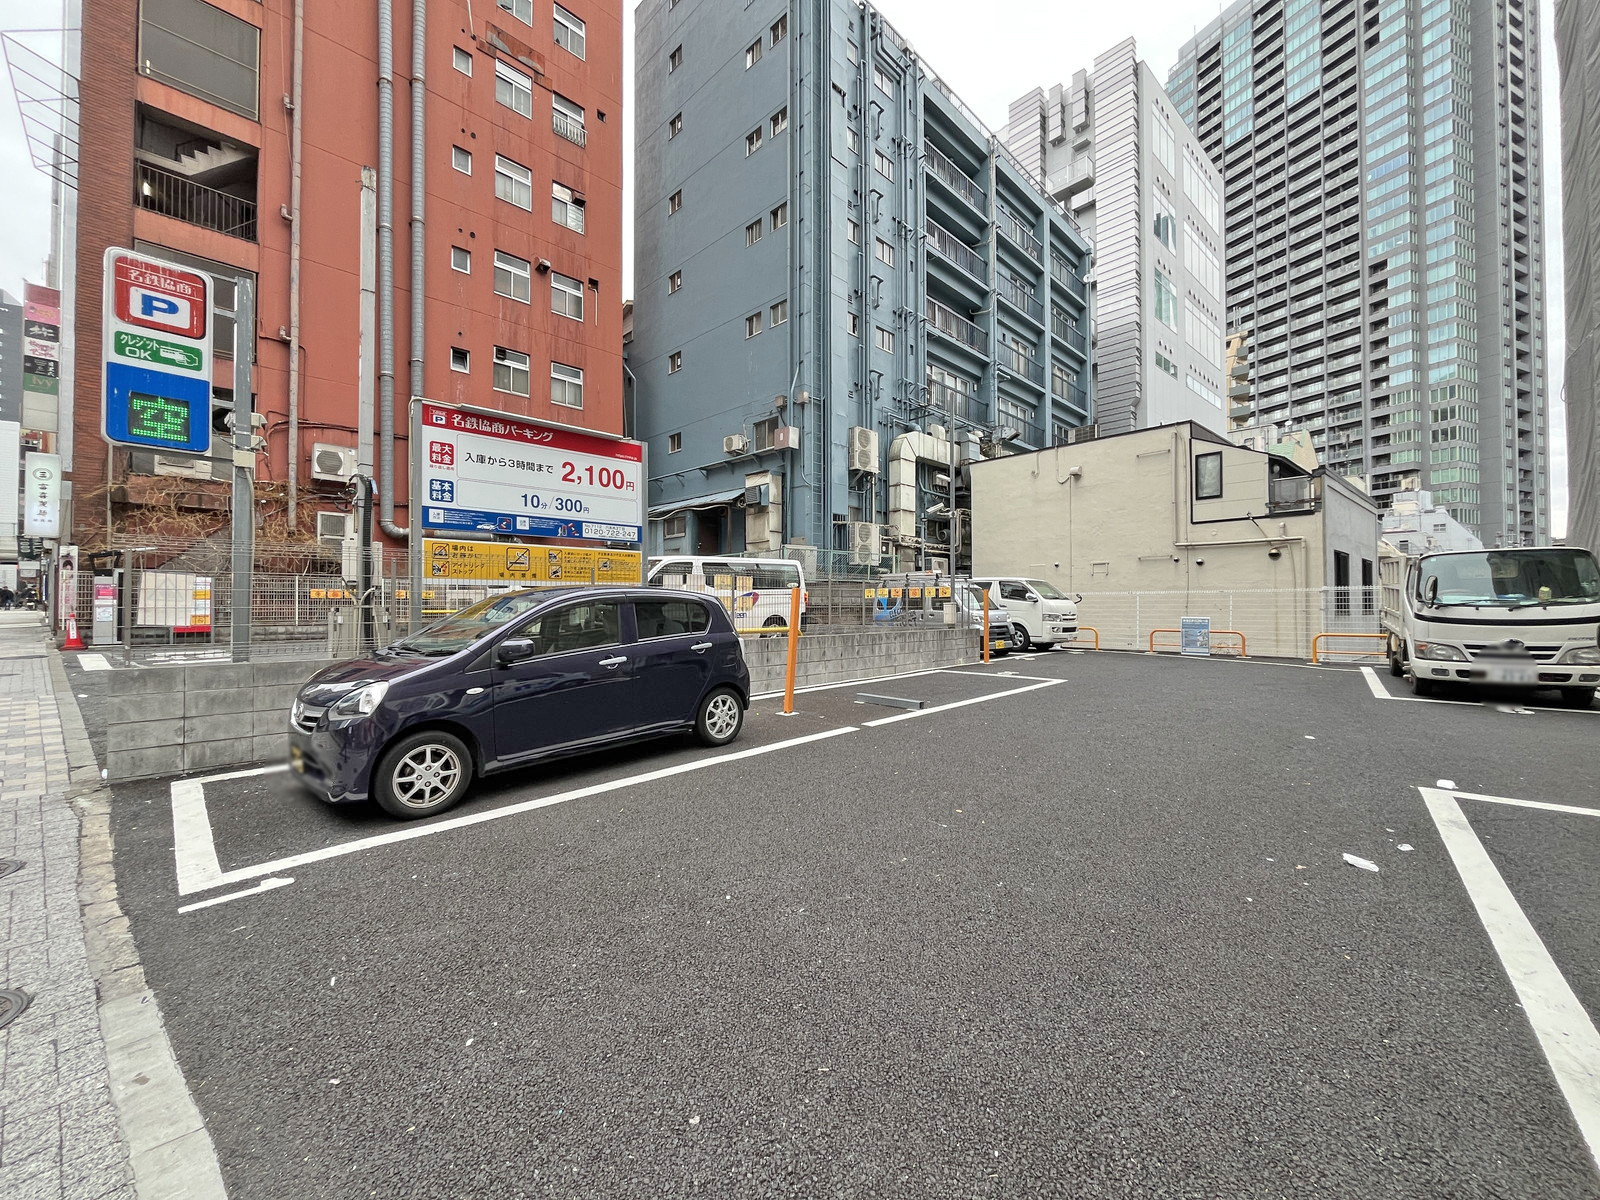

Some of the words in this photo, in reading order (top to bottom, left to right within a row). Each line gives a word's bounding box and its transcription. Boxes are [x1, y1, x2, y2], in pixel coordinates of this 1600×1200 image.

[127, 269, 193, 296] 名鉄協商
[141, 293, 180, 318] P
[119, 333, 160, 351] クレジット
[125, 347, 153, 361] OK
[132, 396, 189, 442] 空
[450, 413, 554, 443] 名鉄協商パーキング
[431, 443, 452, 454] 最大
[431, 453, 452, 464] 料金
[464, 452, 554, 475] 入庫から3時間まで
[561, 461, 635, 492] 2,100円
[431, 480, 452, 492] 基本
[431, 491, 452, 502] 料金
[584, 528, 636, 538] 0120-722-247
[451, 544, 474, 552] 場内は
